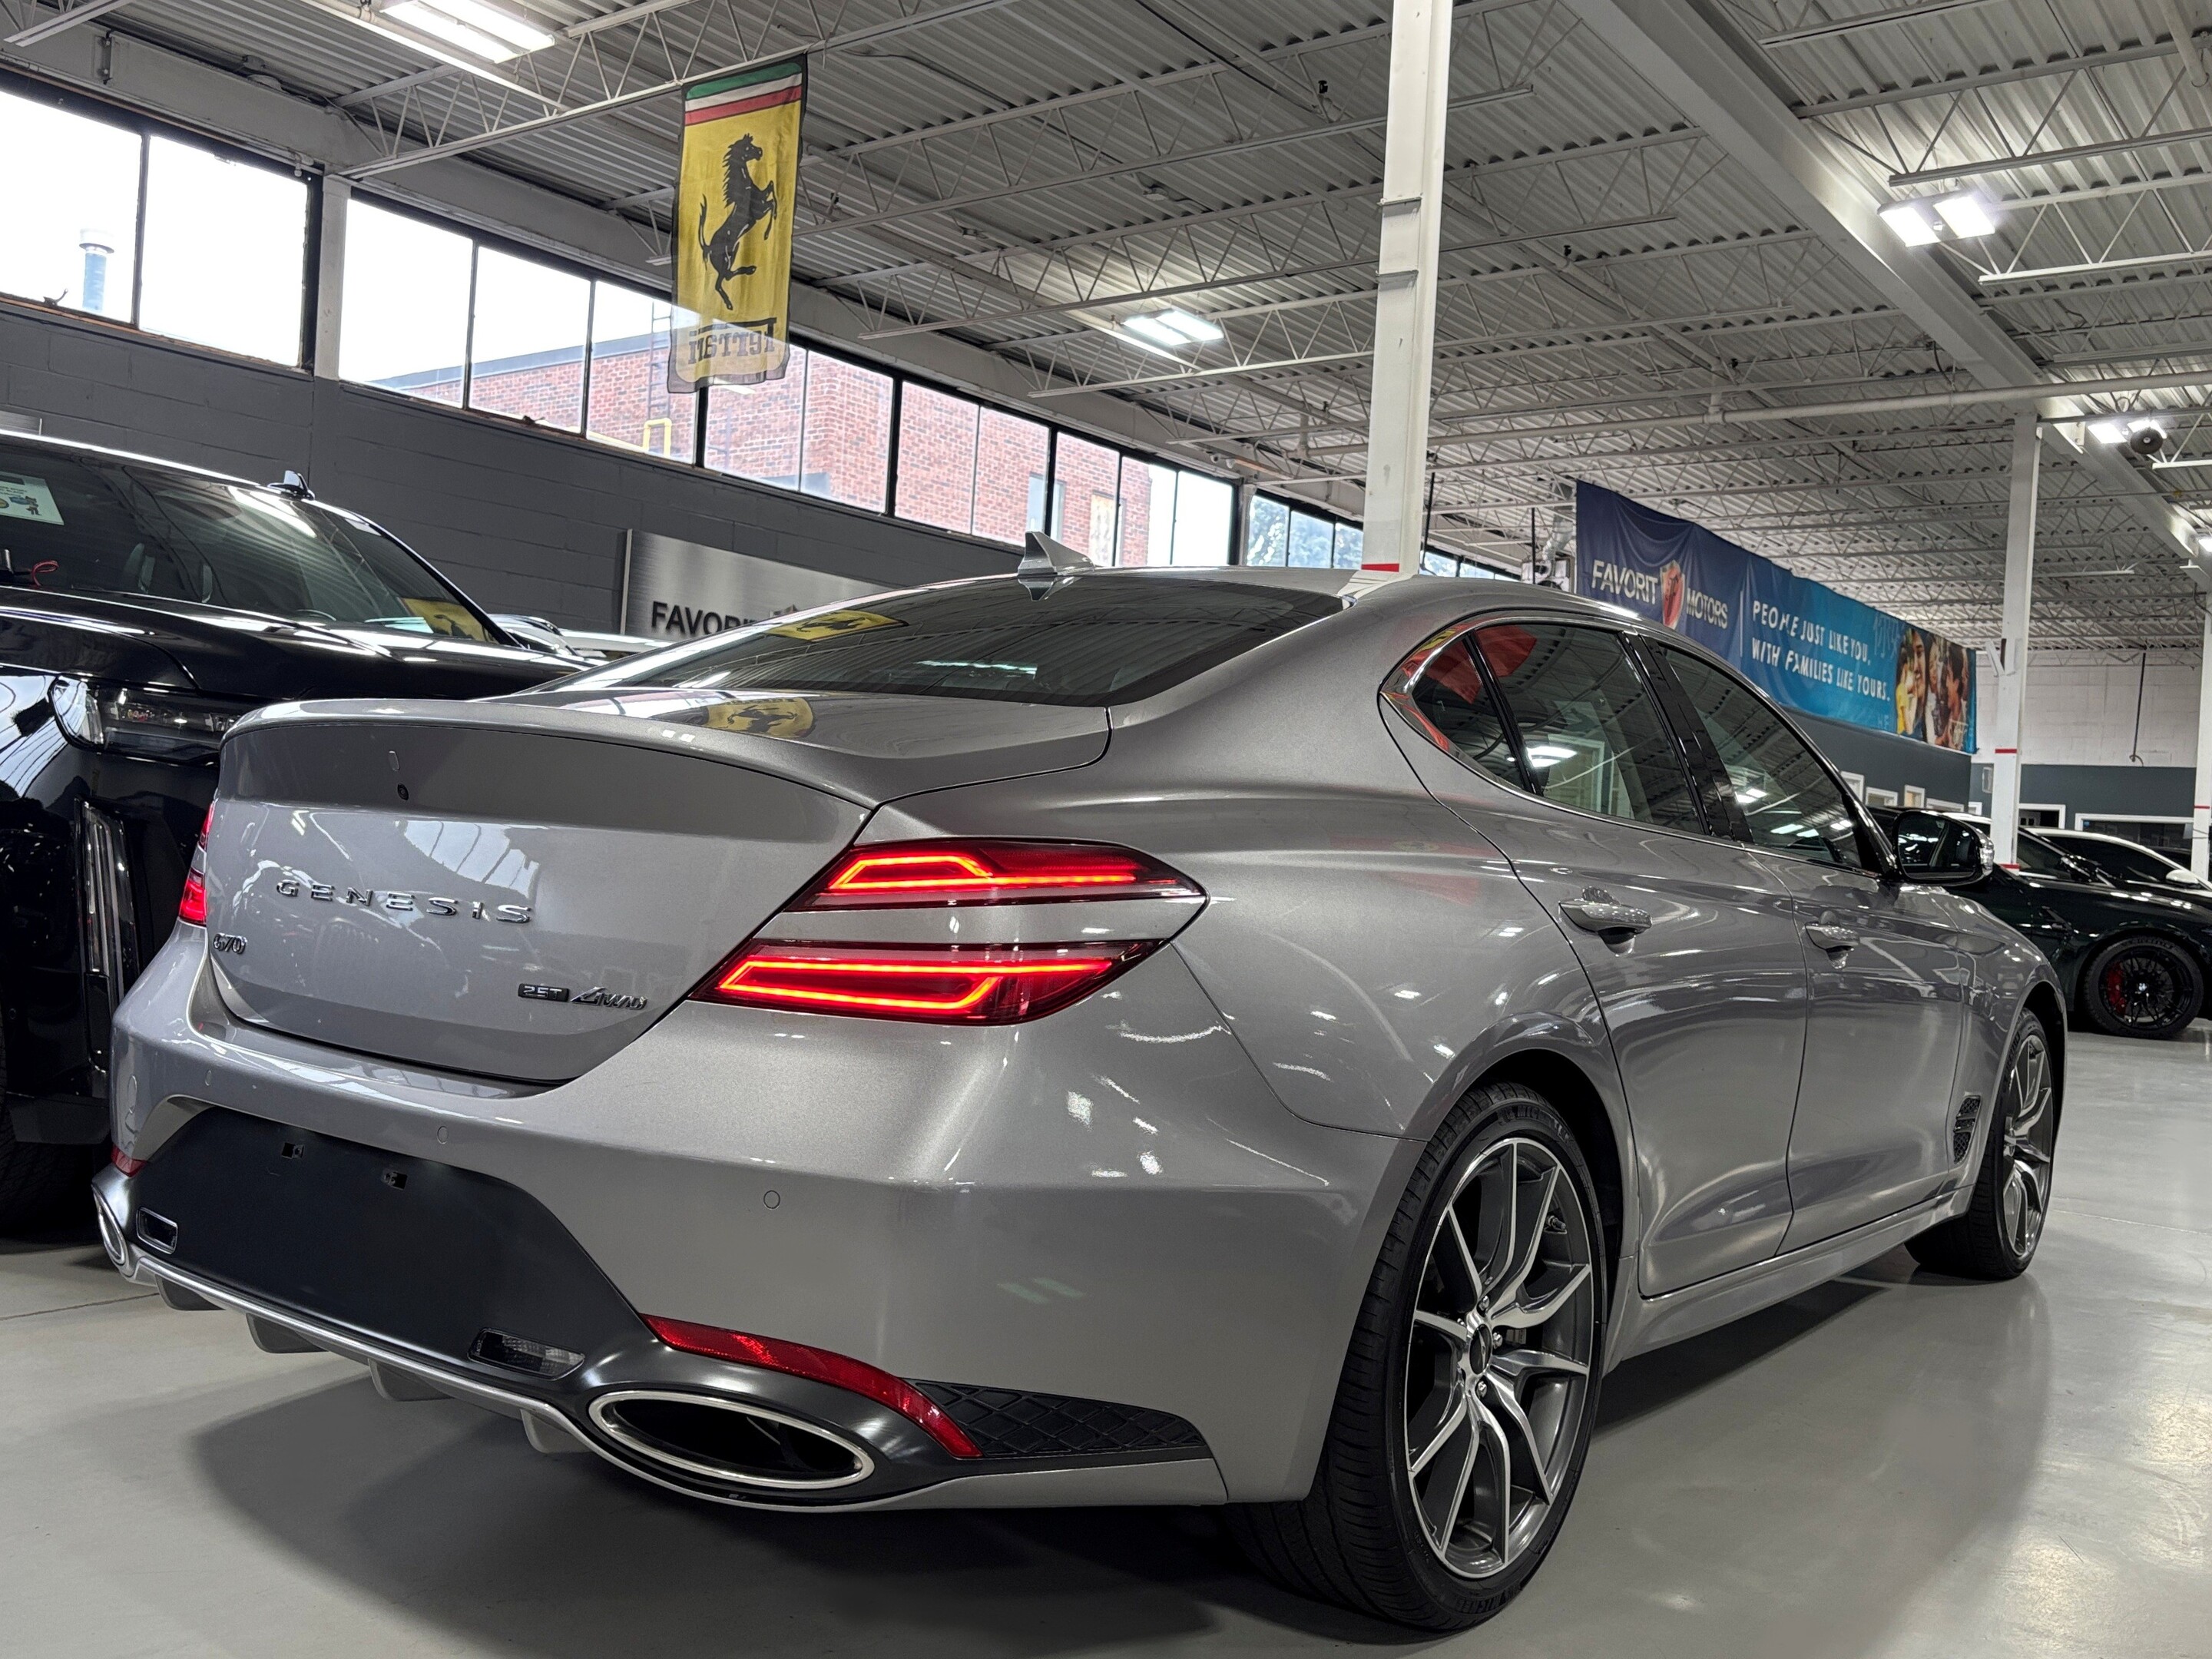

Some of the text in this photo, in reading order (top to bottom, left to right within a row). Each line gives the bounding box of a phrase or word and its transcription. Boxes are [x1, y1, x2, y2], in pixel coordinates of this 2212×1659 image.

[1591, 559, 1658, 604] FAVORIT
[1686, 587, 1728, 629] MOTORS
[651, 601, 757, 636] FAVOR
[1800, 620, 1825, 647] JUST
[1829, 630, 1849, 655] LIKE
[1752, 637, 1781, 667] WITH
[1785, 650, 1833, 684] FAMILIES
[1836, 667, 1853, 691] LIKE
[276, 879, 534, 923] GENESIS
